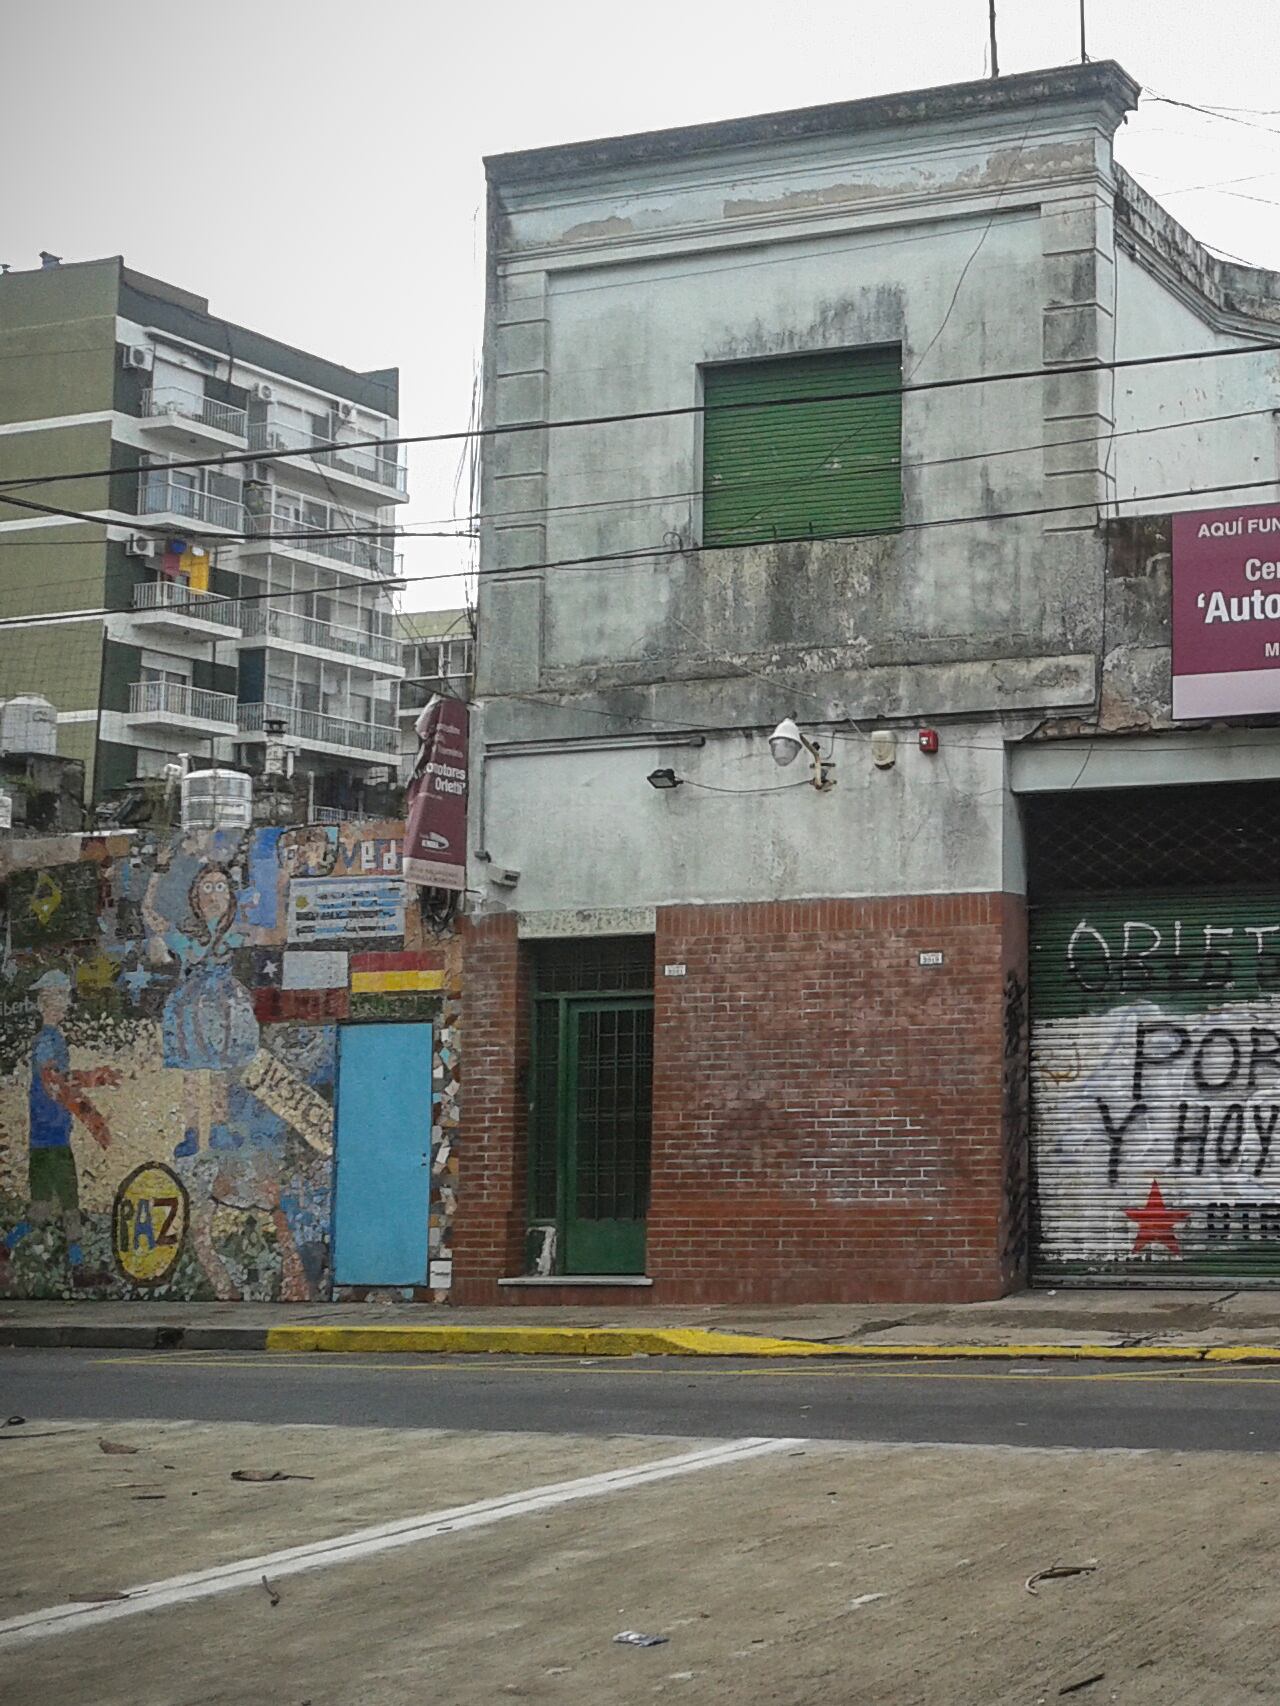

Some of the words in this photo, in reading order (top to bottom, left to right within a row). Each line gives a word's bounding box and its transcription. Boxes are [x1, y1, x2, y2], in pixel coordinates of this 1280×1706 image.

[1197, 515, 1244, 538] AQUÍ
[1095, 1096, 1147, 1185] Y
[119, 1197, 180, 1253] PAZ
